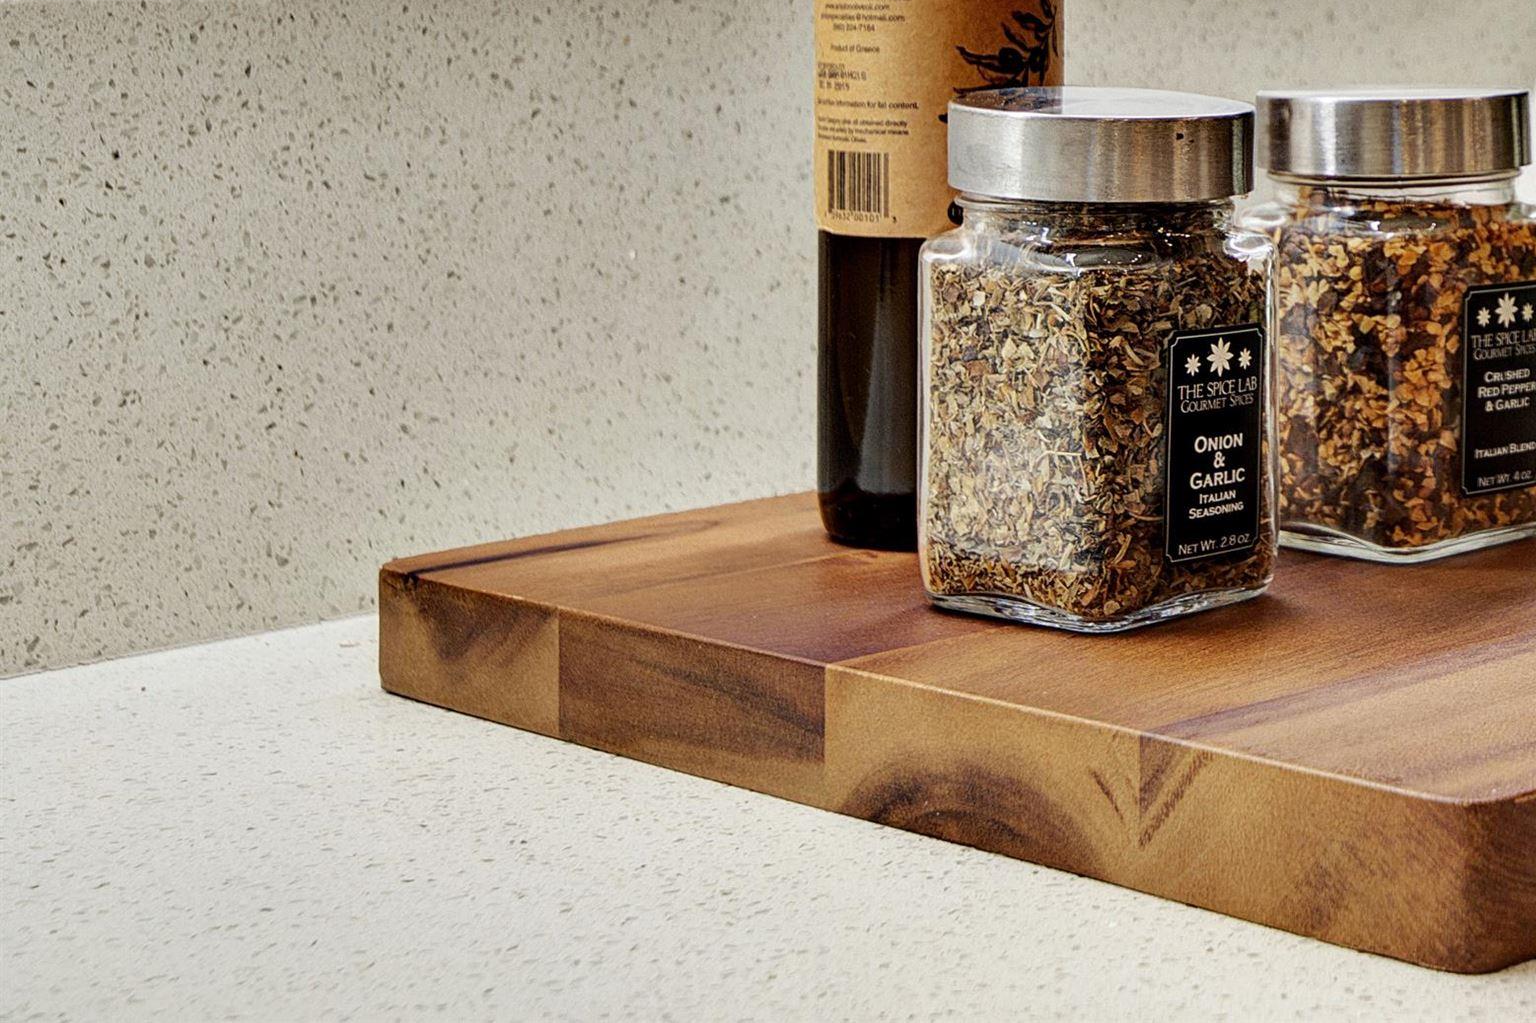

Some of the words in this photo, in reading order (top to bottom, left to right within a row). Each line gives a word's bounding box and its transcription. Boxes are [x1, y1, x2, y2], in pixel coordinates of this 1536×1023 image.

[849, 44, 855, 52] of
[856, 44, 881, 53] Greece
[867, 100, 877, 108] for
[885, 120, 908, 128] directly
[1470, 334, 1494, 349] THE
[1496, 331, 1520, 347] SPICE
[1472, 347, 1513, 361] GOURMET
[1515, 343, 1536, 357] SPICES
[1484, 368, 1531, 383] CRUSHED
[1177, 383, 1204, 401] THE
[1206, 380, 1236, 398] SPICE
[1238, 376, 1258, 394] LAB
[1477, 384, 1500, 399] RED
[1501, 380, 1536, 397] PEPPER
[1180, 399, 1227, 414] GOURMET
[1230, 393, 1255, 408] SPICES
[1485, 400, 1494, 413] &
[1495, 396, 1531, 411] GARLIC
[1193, 432, 1244, 454] ONION
[1475, 445, 1509, 460] ITALIAN
[1509, 440, 1536, 455] BLEND
[1212, 451, 1226, 469] &
[1189, 467, 1246, 490] GARLIC
[1477, 475, 1496, 489] NET
[1513, 470, 1521, 481] 4
[1198, 489, 1237, 505] ITALIAN
[1188, 501, 1245, 520] SEASONING
[1178, 542, 1198, 556] NET
